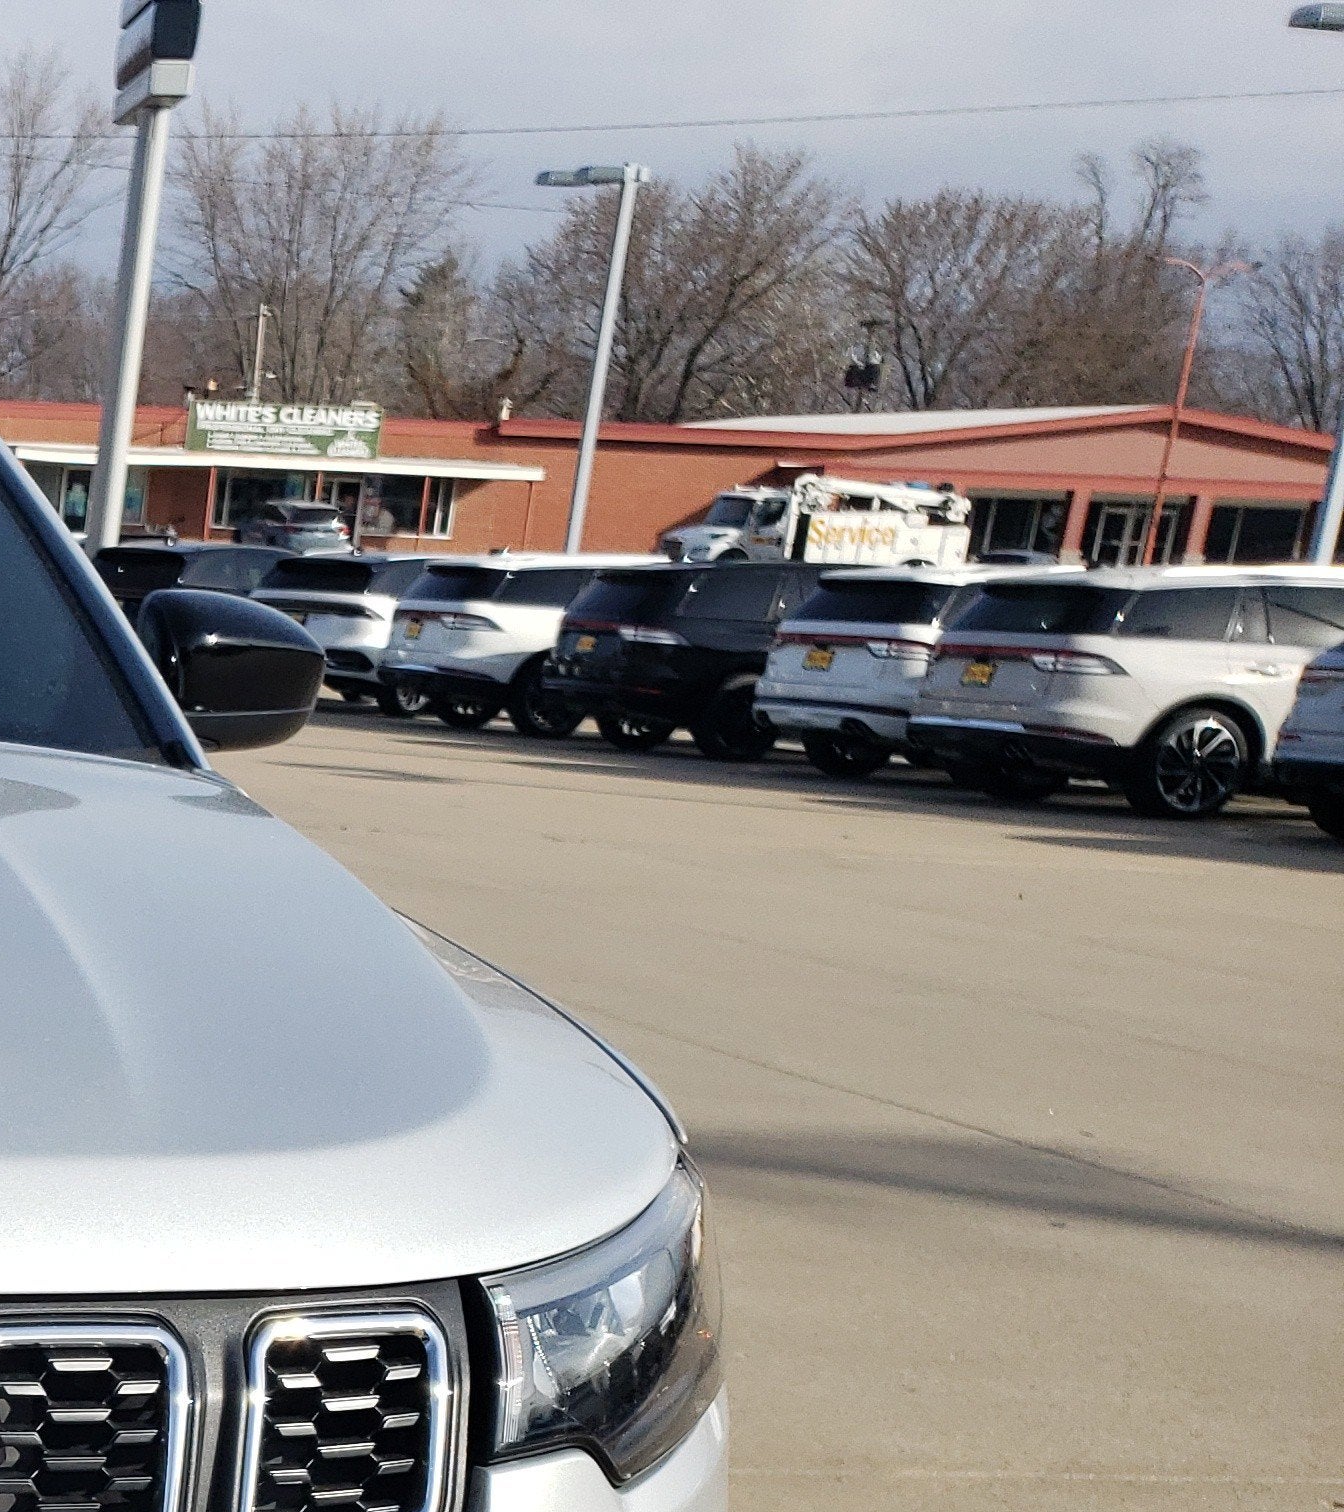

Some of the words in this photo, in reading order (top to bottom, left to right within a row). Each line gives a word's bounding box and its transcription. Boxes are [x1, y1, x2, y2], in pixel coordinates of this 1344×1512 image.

[196, 402, 278, 424] WHITE'S
[279, 406, 381, 429] CLEANERS
[808, 518, 897, 546] Service
